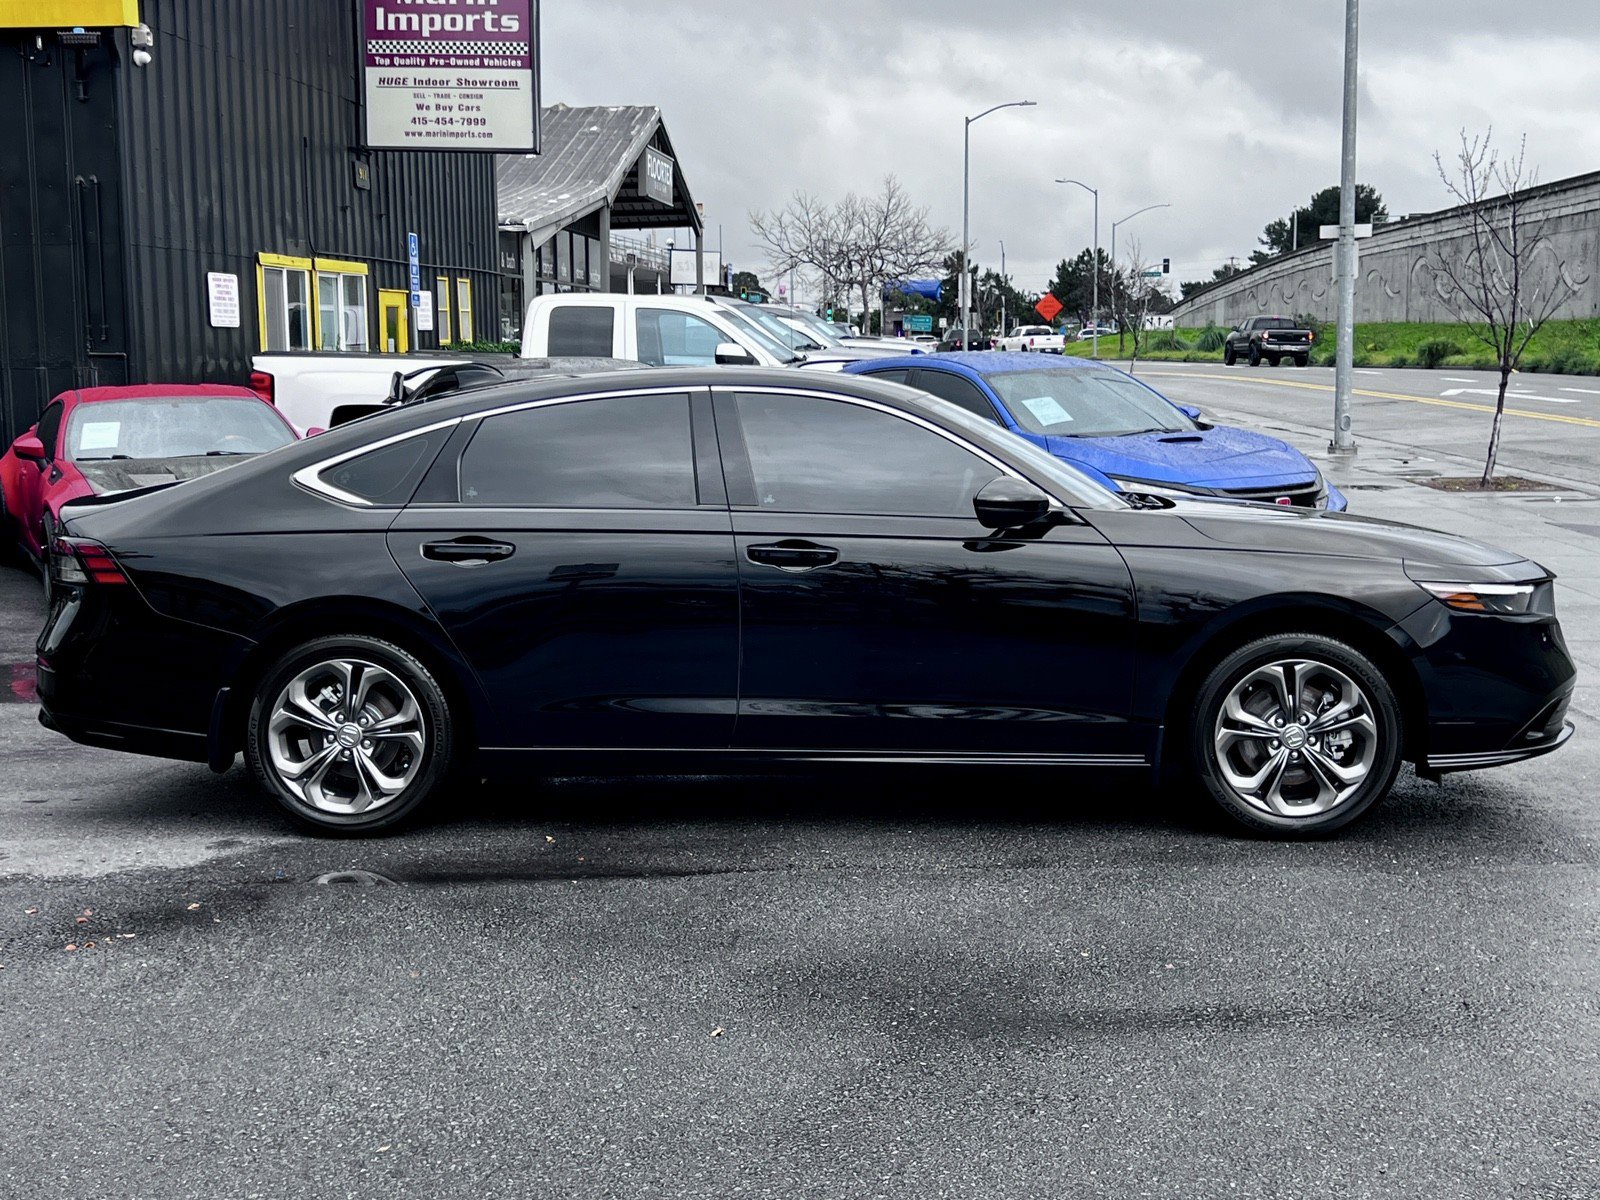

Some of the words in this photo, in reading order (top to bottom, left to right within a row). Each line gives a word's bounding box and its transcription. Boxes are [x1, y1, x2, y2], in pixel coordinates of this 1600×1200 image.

[376, 7, 519, 37] Imports
[374, 56, 390, 66] Top
[393, 56, 426, 67] Quality
[429, 57, 480, 67] Pre-Owned
[483, 58, 522, 67] Vehicles
[378, 76, 409, 86] HUGE
[413, 77, 451, 87] Indoor
[456, 77, 519, 88] Showroom
[416, 103, 431, 111] We
[435, 104, 453, 112] Buy
[458, 104, 481, 112] Cars
[411, 116, 487, 126] 415-454-7999
[404, 130, 493, 139] www.marinimports.com
